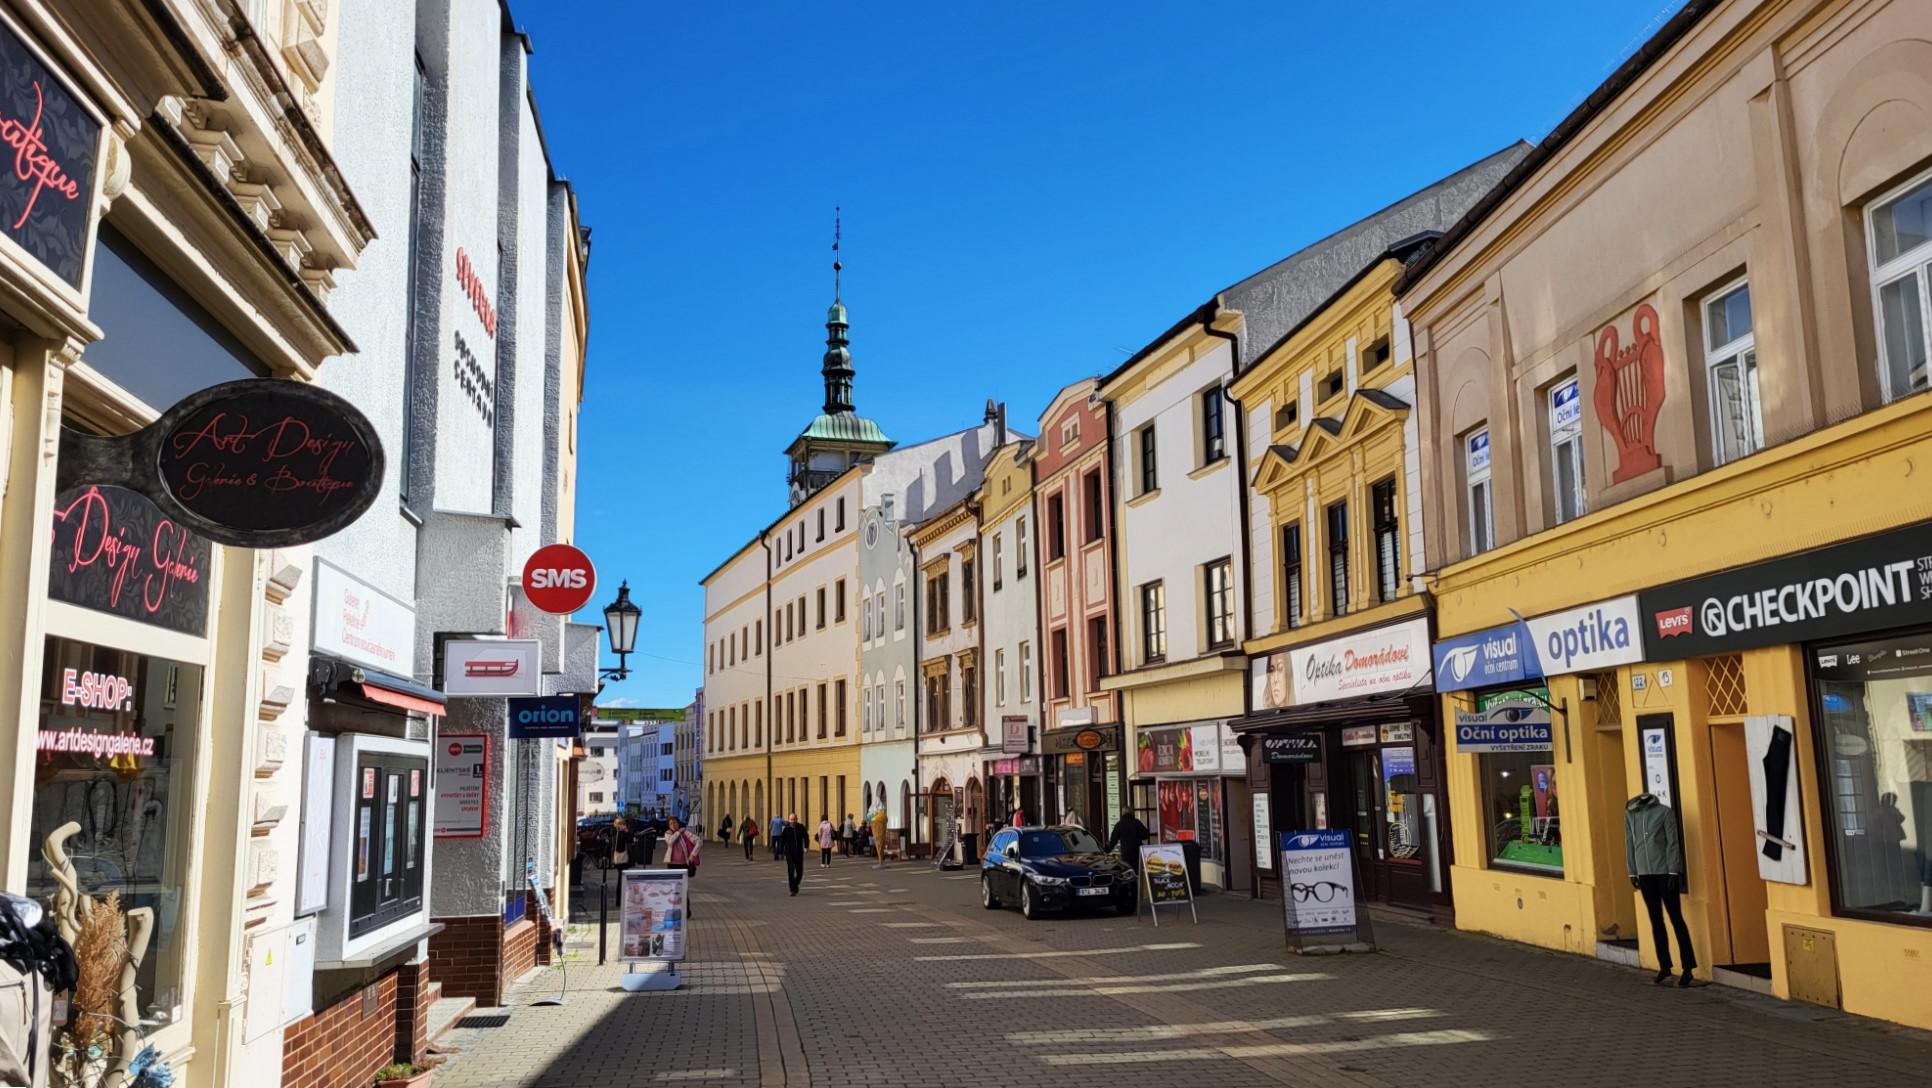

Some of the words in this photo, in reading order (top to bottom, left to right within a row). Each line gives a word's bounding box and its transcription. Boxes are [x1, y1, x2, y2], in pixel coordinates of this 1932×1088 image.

[262, 416, 356, 473] Design
[245, 472, 257, 487] &
[62, 484, 142, 608] Design
[530, 567, 588, 590] SMS
[1727, 560, 1914, 631] CHECKPOINT
[1483, 632, 1516, 659] visual
[1548, 609, 1630, 669] optika
[1495, 658, 1519, 673] centrum
[1846, 653, 1861, 665] Lee
[1305, 653, 1342, 687] Optika
[62, 667, 133, 712] E-SHOP:
[518, 704, 574, 723] orion
[1459, 713, 1487, 723] visual
[1265, 739, 1318, 749] OPTIKA
[1460, 726, 1496, 740] Oční
[1499, 726, 1549, 742] optika
[1320, 833, 1345, 842] visual
